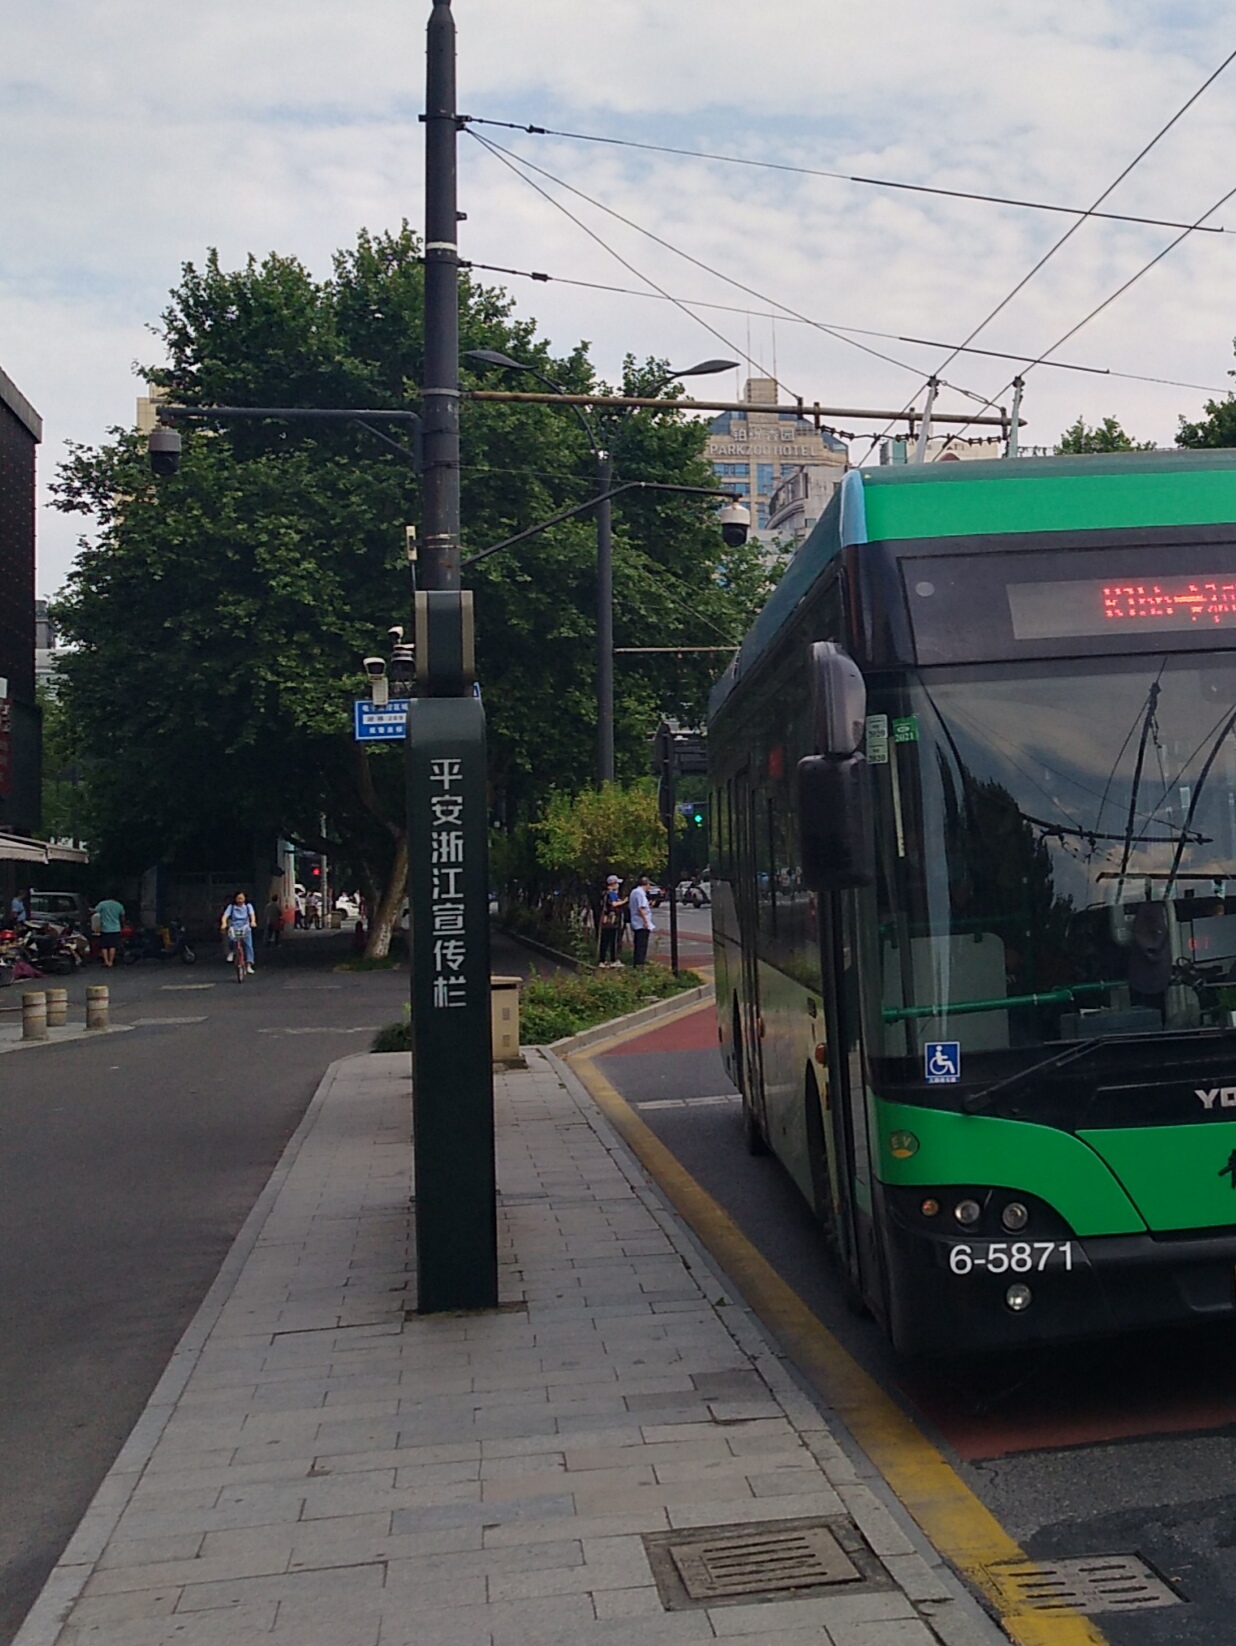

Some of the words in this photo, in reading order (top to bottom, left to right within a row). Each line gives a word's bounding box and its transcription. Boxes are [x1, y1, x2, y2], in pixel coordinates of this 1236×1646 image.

[710, 444, 772, 456] PARKZOO
[774, 445, 818, 457] HOTEL
[430, 758, 467, 1009] 平安浙江宣传栏
[890, 1135, 913, 1149] EV
[949, 1241, 1073, 1276] 6-5871
